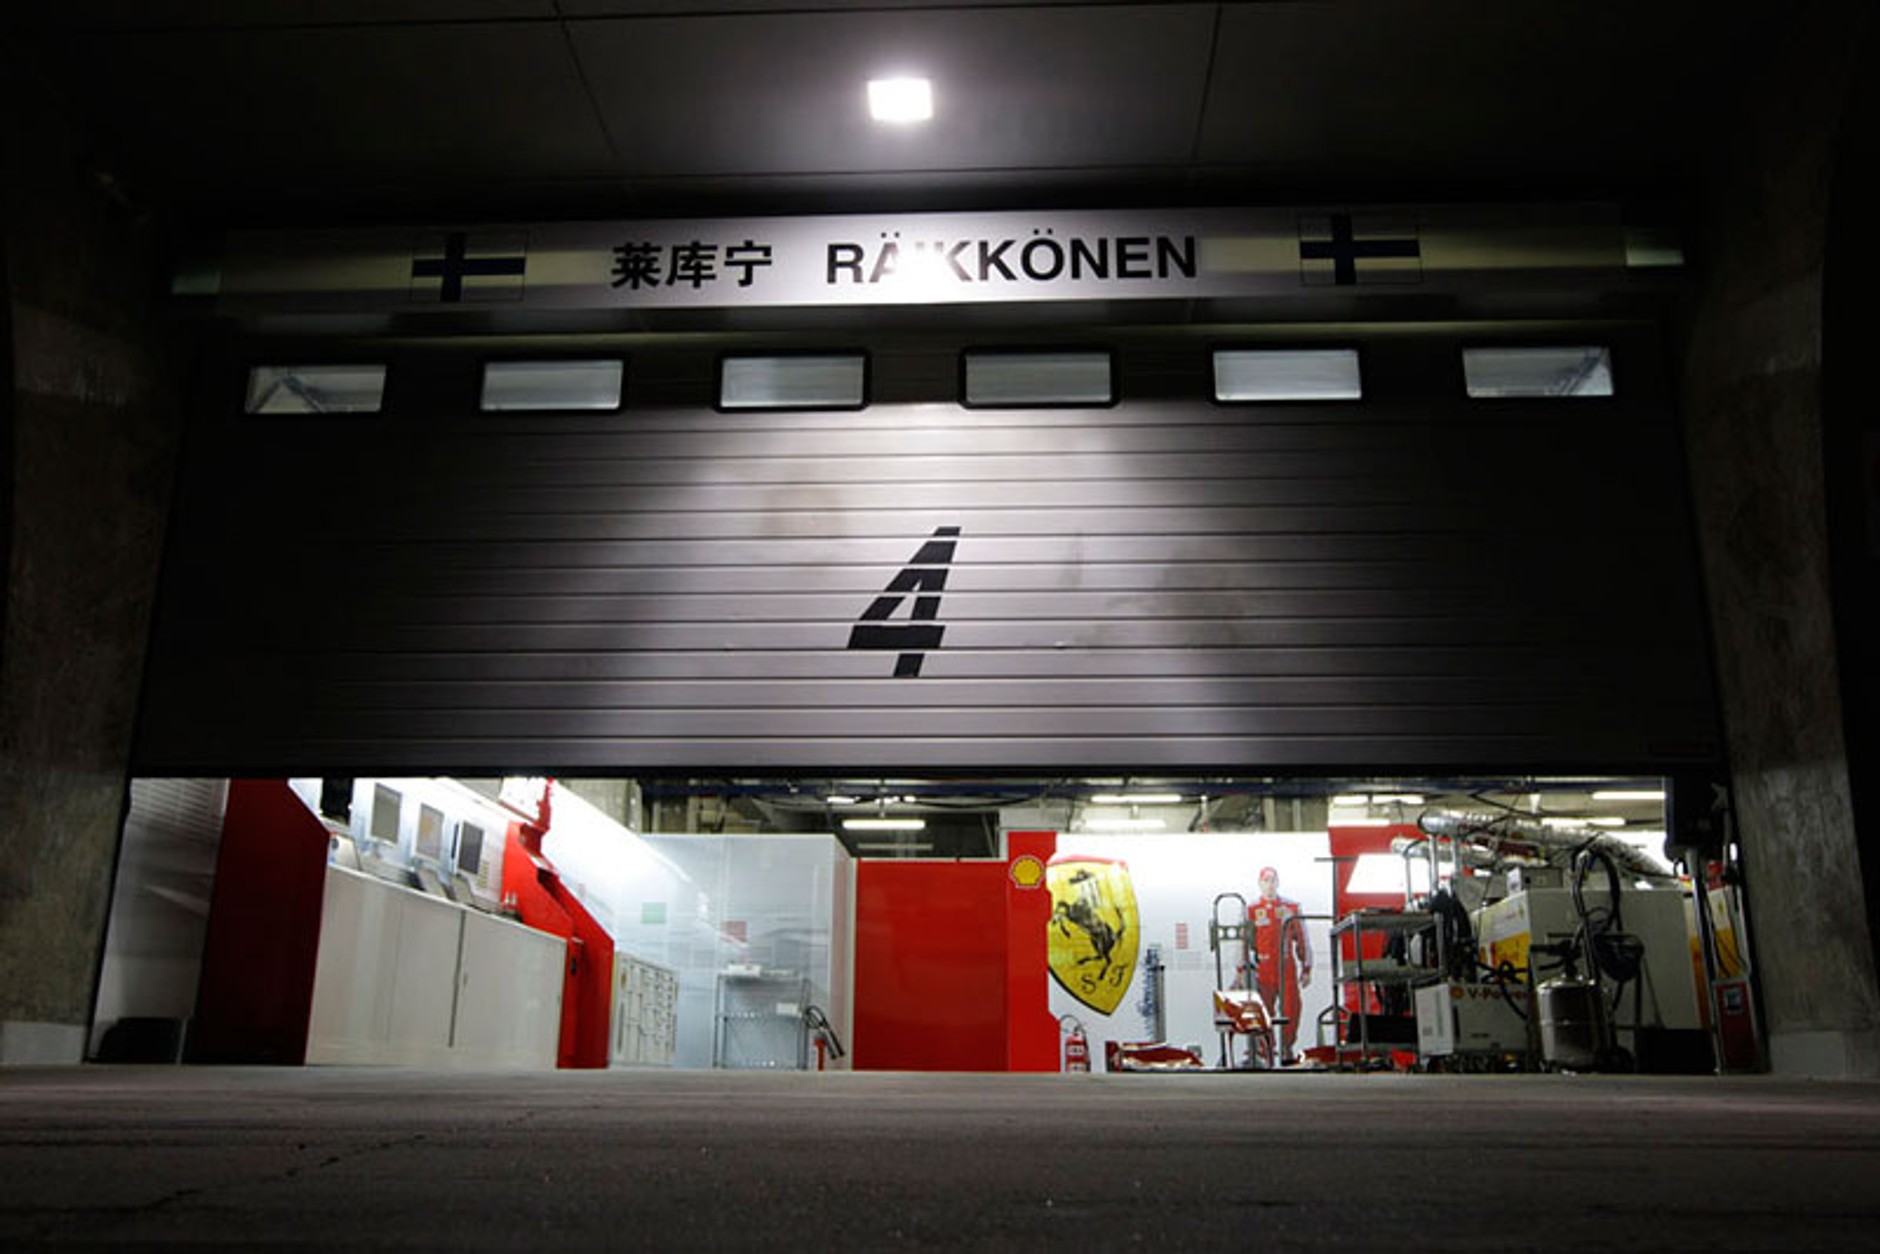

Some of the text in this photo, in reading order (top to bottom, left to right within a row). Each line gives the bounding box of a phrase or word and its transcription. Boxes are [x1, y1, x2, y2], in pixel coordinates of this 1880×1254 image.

[611, 240, 772, 289] 莱库宁
[827, 229, 1196, 284] RÄKKÖNEN
[847, 526, 961, 678] 4
[1081, 972, 1097, 994] S
